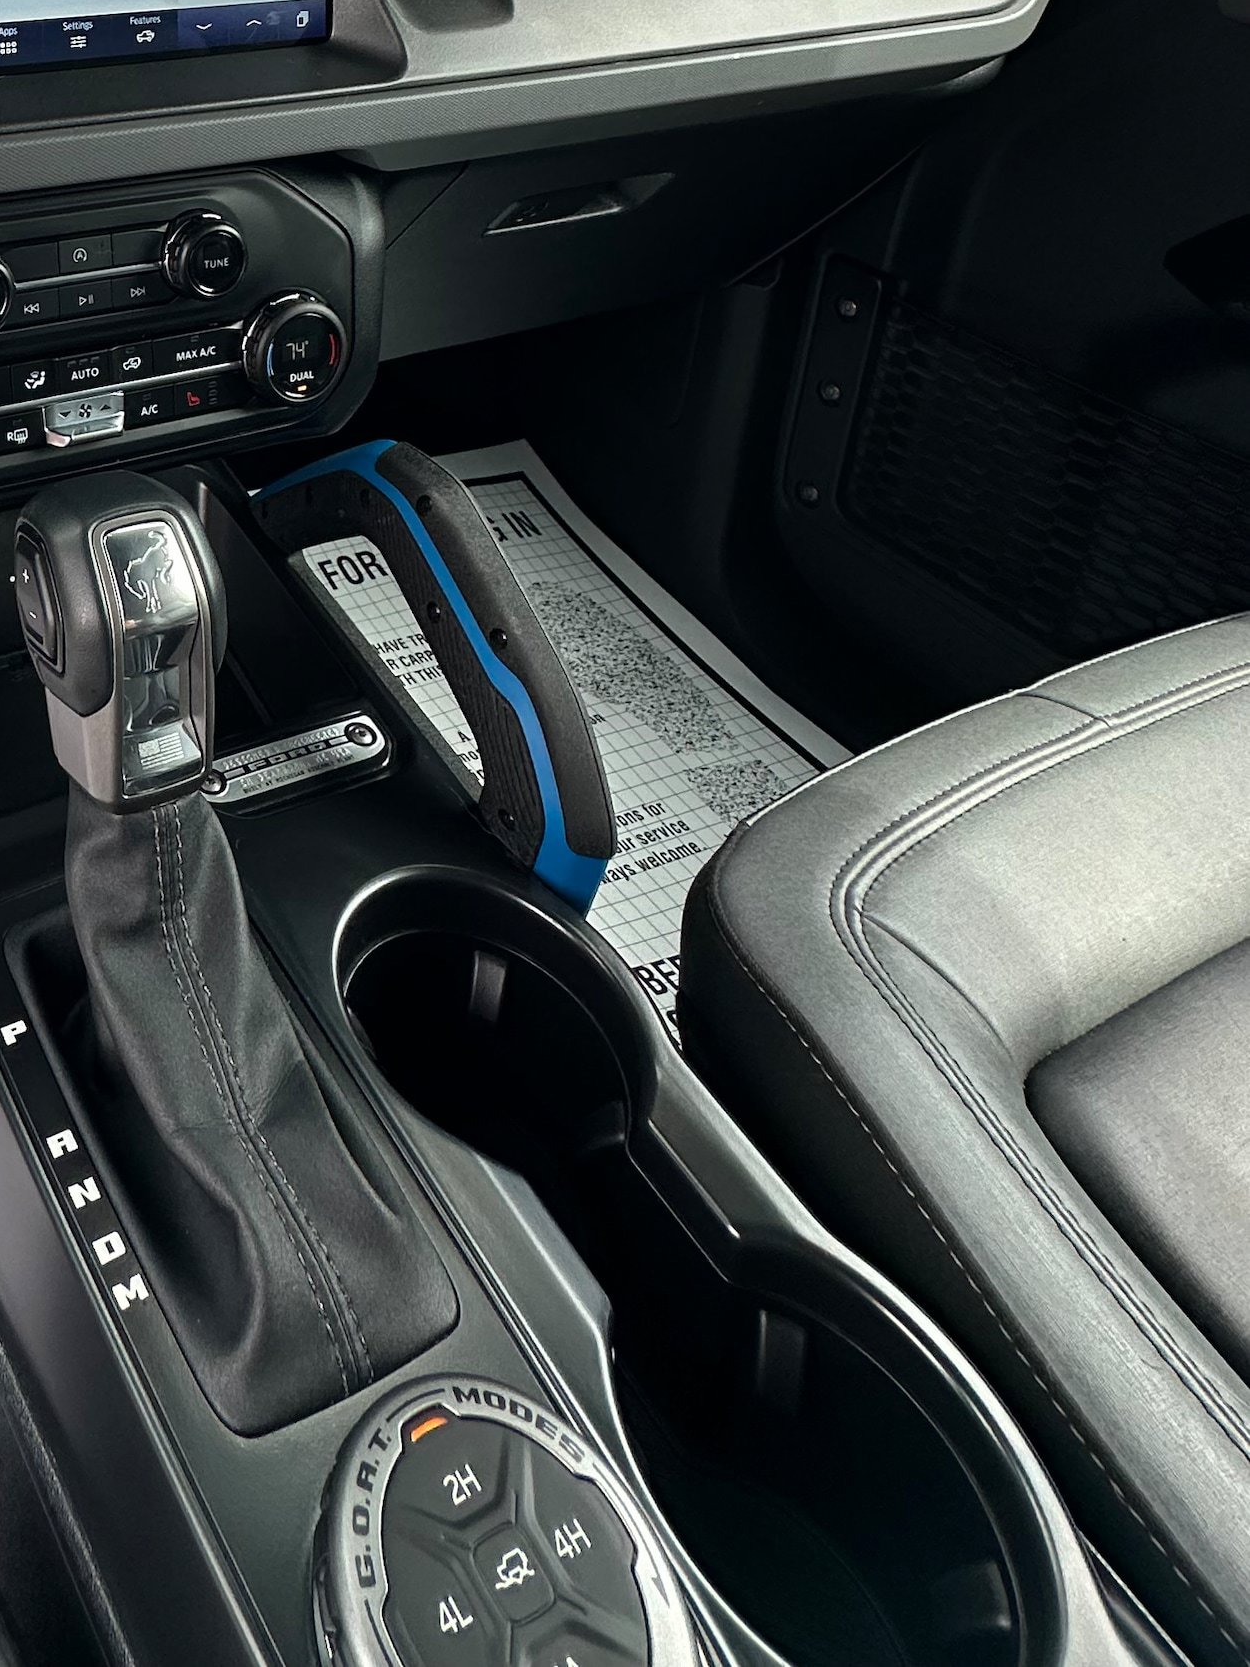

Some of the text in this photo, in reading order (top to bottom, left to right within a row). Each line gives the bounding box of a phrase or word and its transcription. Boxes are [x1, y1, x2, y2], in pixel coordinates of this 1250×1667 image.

[62, 20, 93, 32] Settings
[129, 14, 161, 26] Features
[203, 256, 230, 270] TUNE
[176, 344, 217, 362] MAX A/C
[71, 366, 100, 381] AUTO
[289, 370, 315, 383] DUAL
[140, 403, 159, 417] A/C
[6, 431, 15, 442] R
[501, 510, 543, 539] IN
[317, 549, 389, 591] FOR
[374, 637, 410, 656] HAVE
[456, 729, 471, 744] A
[248, 741, 327, 771] FORD
[643, 801, 667, 816] for
[635, 819, 690, 846] service
[601, 840, 708, 885] ways welcome.
[0, 1019, 28, 1047] P
[67, 1175, 102, 1210] N
[91, 1230, 127, 1266] D
[111, 1272, 150, 1311] M
[451, 1385, 587, 1465] MODES
[442, 1463, 483, 1507] 2H
[352, 1426, 395, 1590] G.O.A.T.
[552, 1518, 593, 1560] 4H
[437, 1595, 475, 1635] 4L
